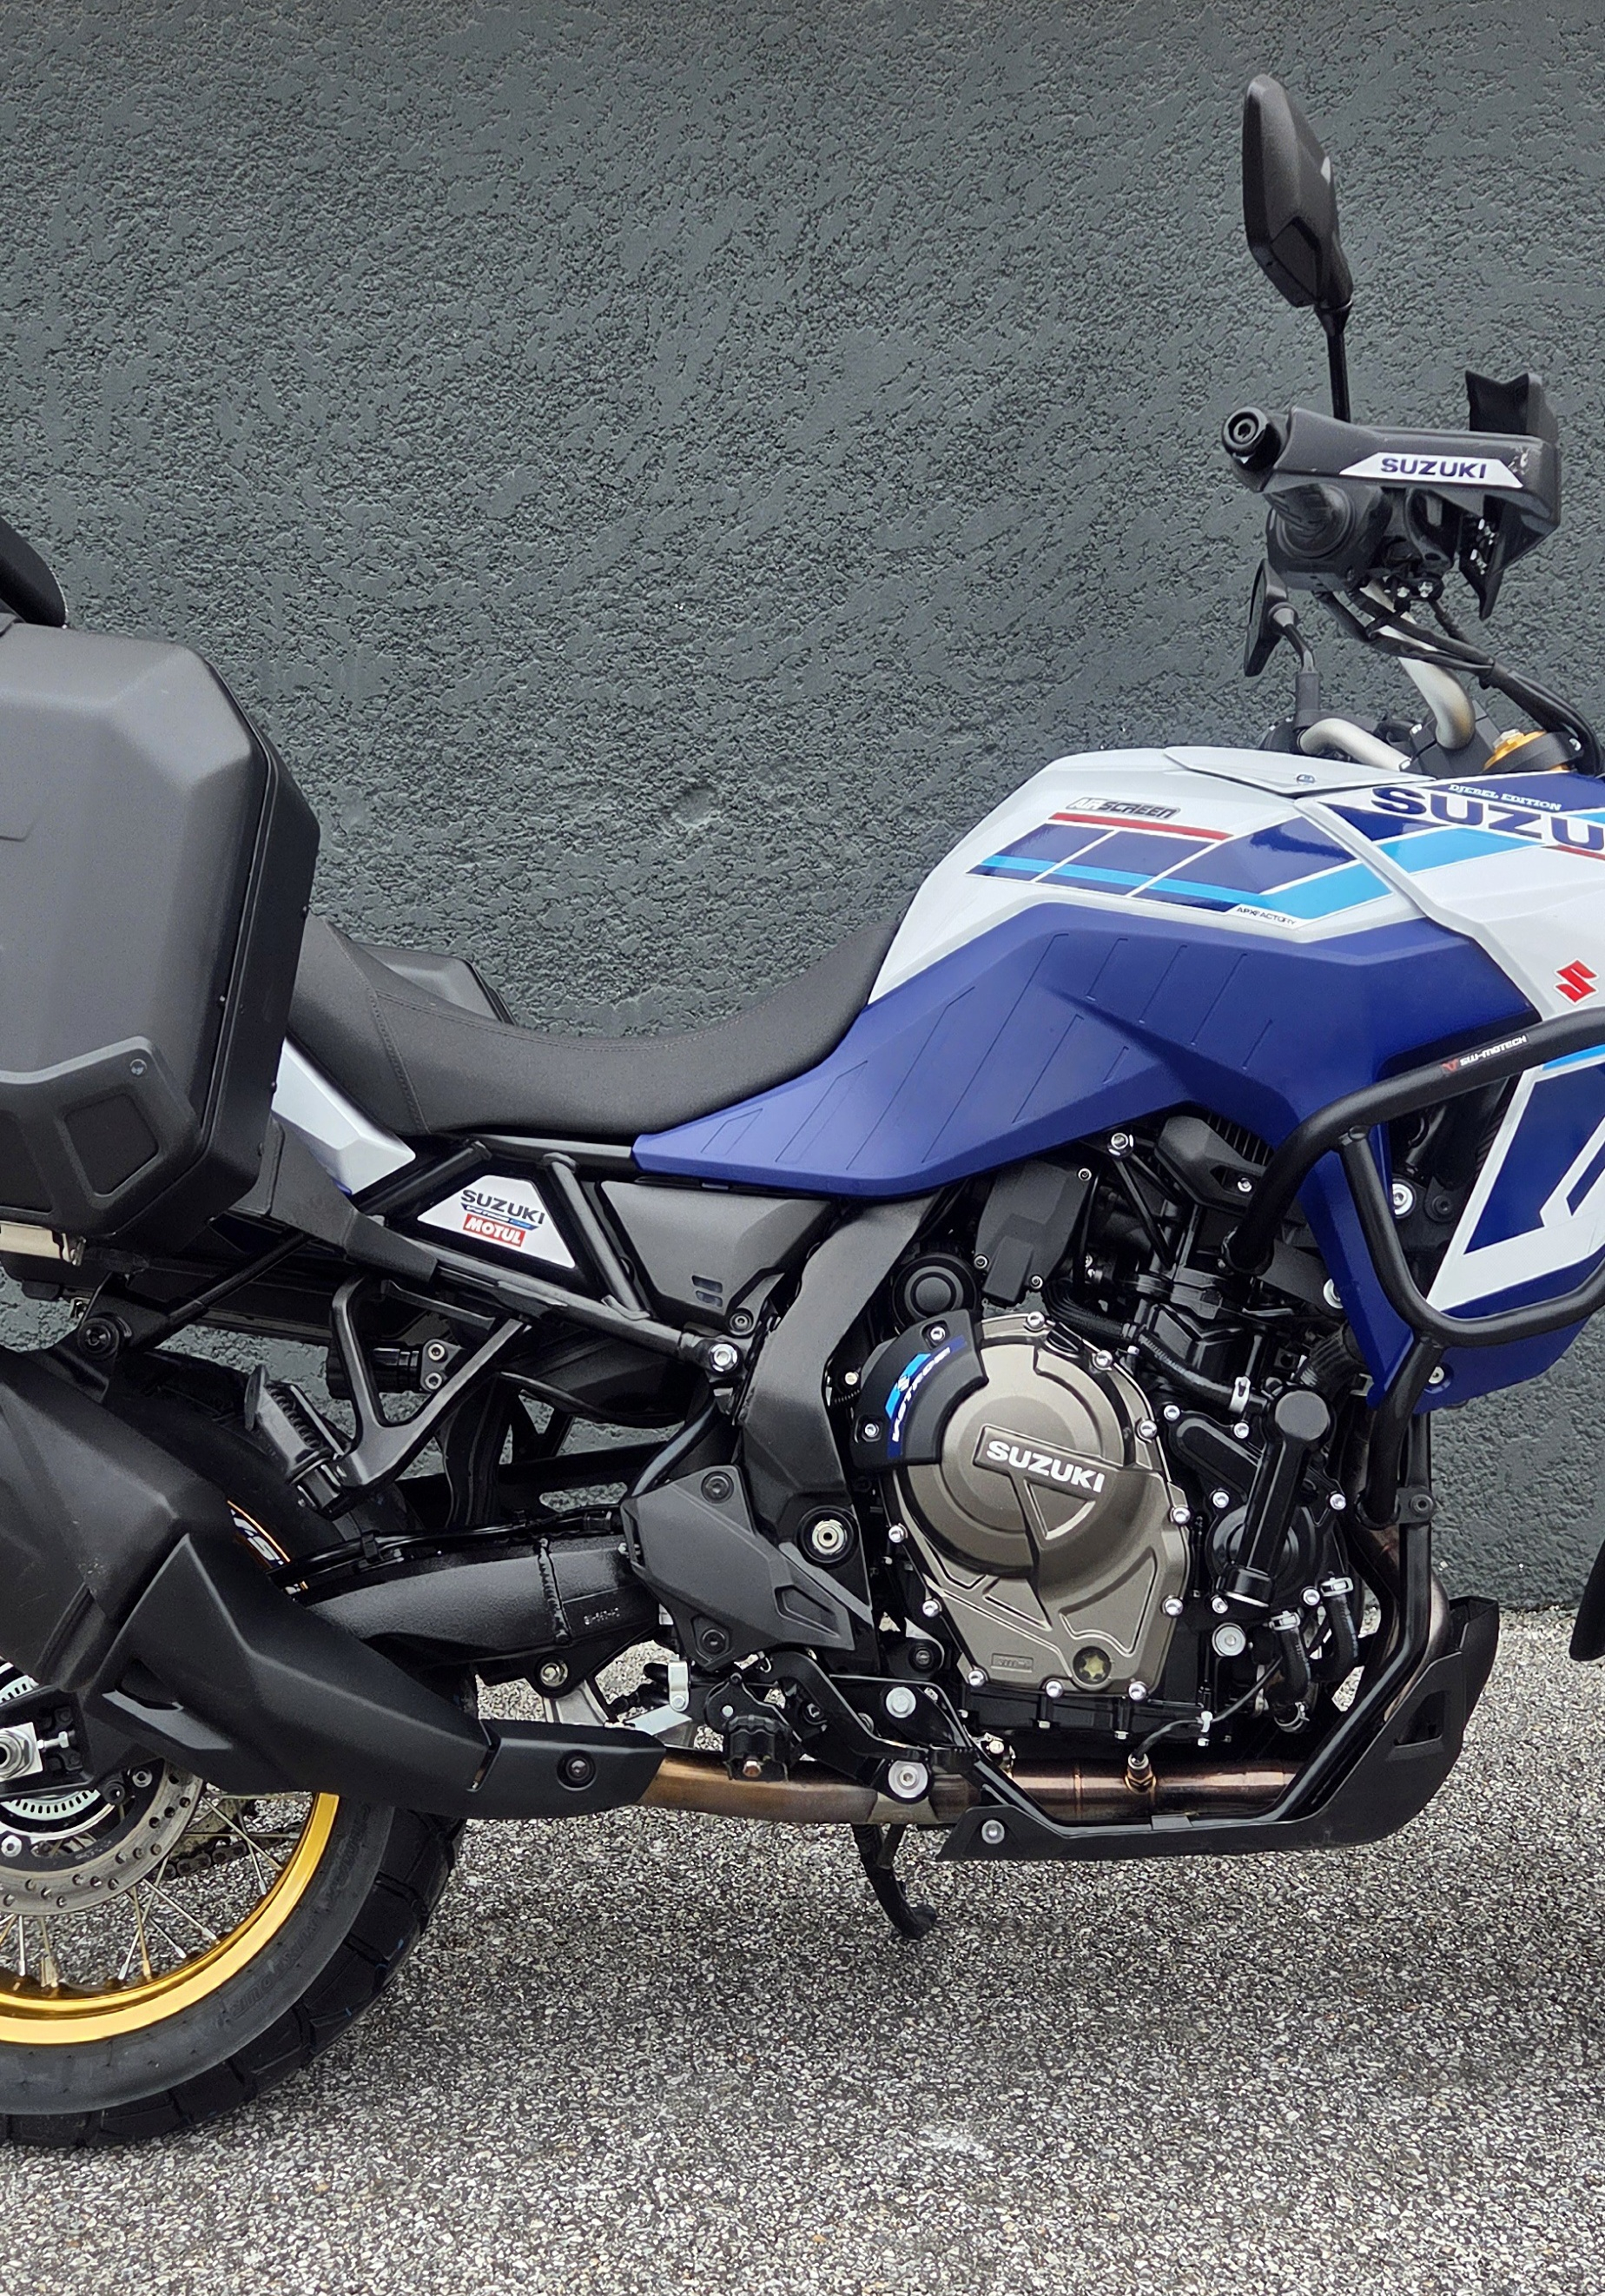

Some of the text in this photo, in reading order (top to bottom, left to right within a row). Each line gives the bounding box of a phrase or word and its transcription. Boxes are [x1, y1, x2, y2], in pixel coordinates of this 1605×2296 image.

[1380, 457, 1487, 479] SUZUKI
[1448, 783, 1562, 811] DJEBEL EDITION
[1371, 785, 1605, 851] SUZU
[1459, 1035, 1528, 1067] SW-MOTECH
[460, 1188, 545, 1225] SUZUKI
[465, 1216, 522, 1245] MOTUL
[986, 1439, 1106, 1493] SUZUKI
